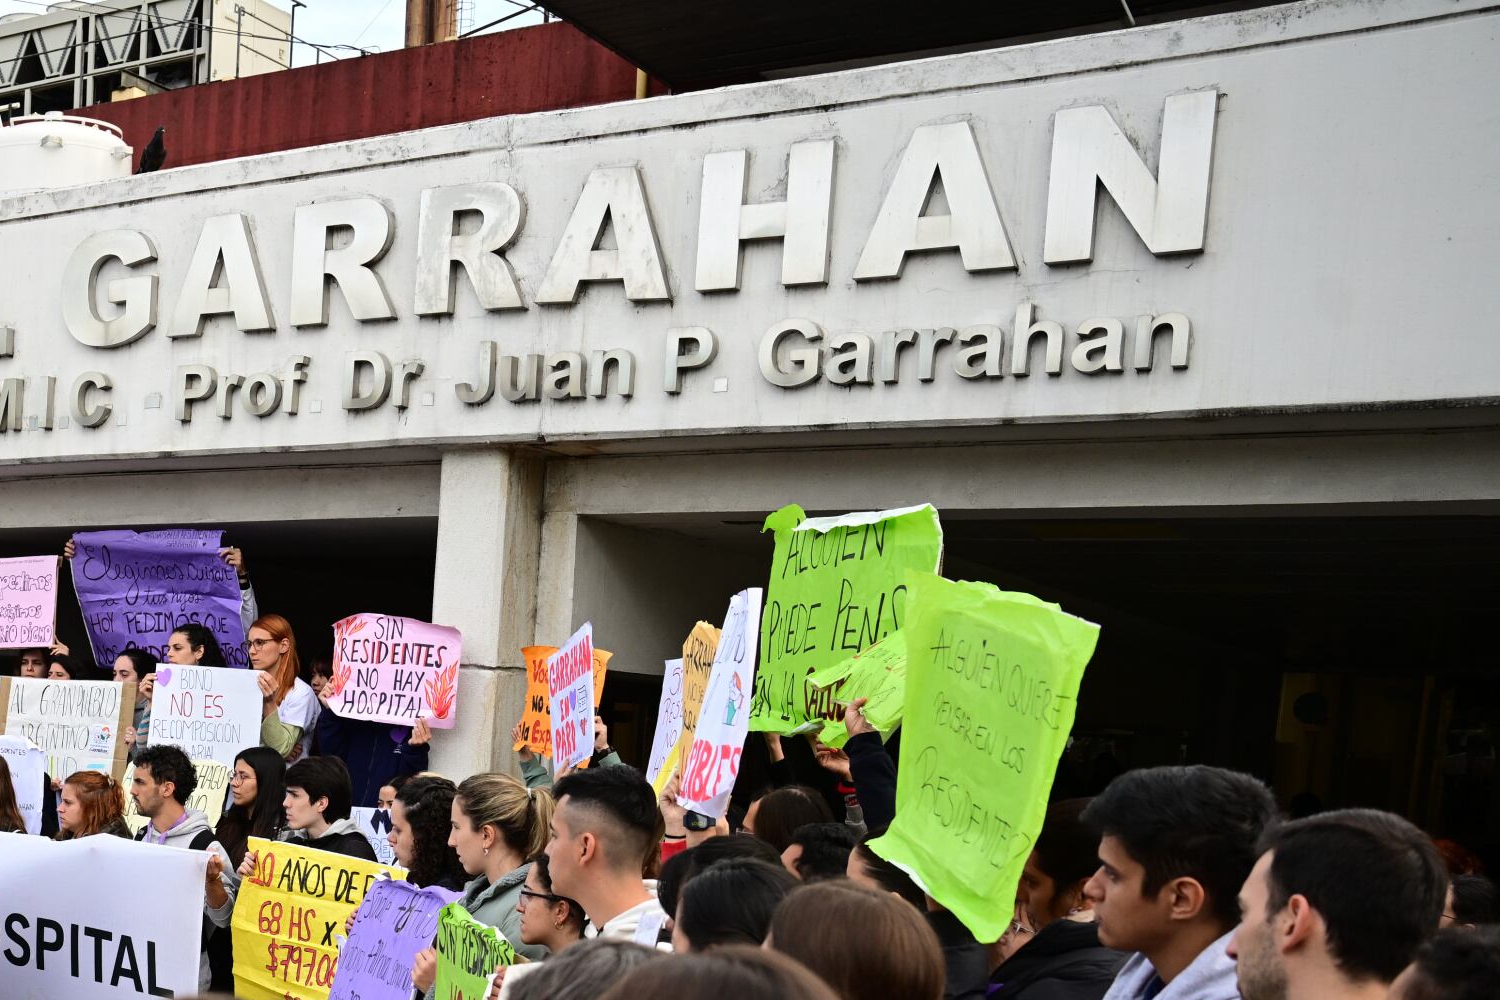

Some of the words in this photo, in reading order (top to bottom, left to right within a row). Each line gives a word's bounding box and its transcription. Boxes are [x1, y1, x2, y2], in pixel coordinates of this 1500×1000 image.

[62, 88, 1222, 349] GARRAHAN
[455, 340, 637, 404] Juan
[758, 303, 1194, 389] Garrahan
[0, 571, 52, 601] pedimos
[90, 612, 114, 635] HOY
[374, 617, 404, 641] SIN
[768, 600, 821, 663] PUEDE
[340, 638, 448, 668] RESIDENTES
[180, 668, 213, 691] BONO
[357, 668, 378, 690] NO
[393, 669, 425, 692] HAY
[11, 684, 27, 714] AL
[40, 685, 76, 717] GRAN
[170, 692, 193, 718] NO
[203, 694, 224, 718] ES
[339, 690, 425, 719] HOSPITAL
[531, 695, 544, 713] NO
[559, 695, 570, 721] EN
[152, 718, 241, 744] RECOMPOSICIÓN
[555, 719, 576, 763] PARO
[277, 856, 331, 898] AÑOS
[334, 868, 360, 905] DE
[258, 900, 283, 936] 68
[288, 906, 316, 942] HS
